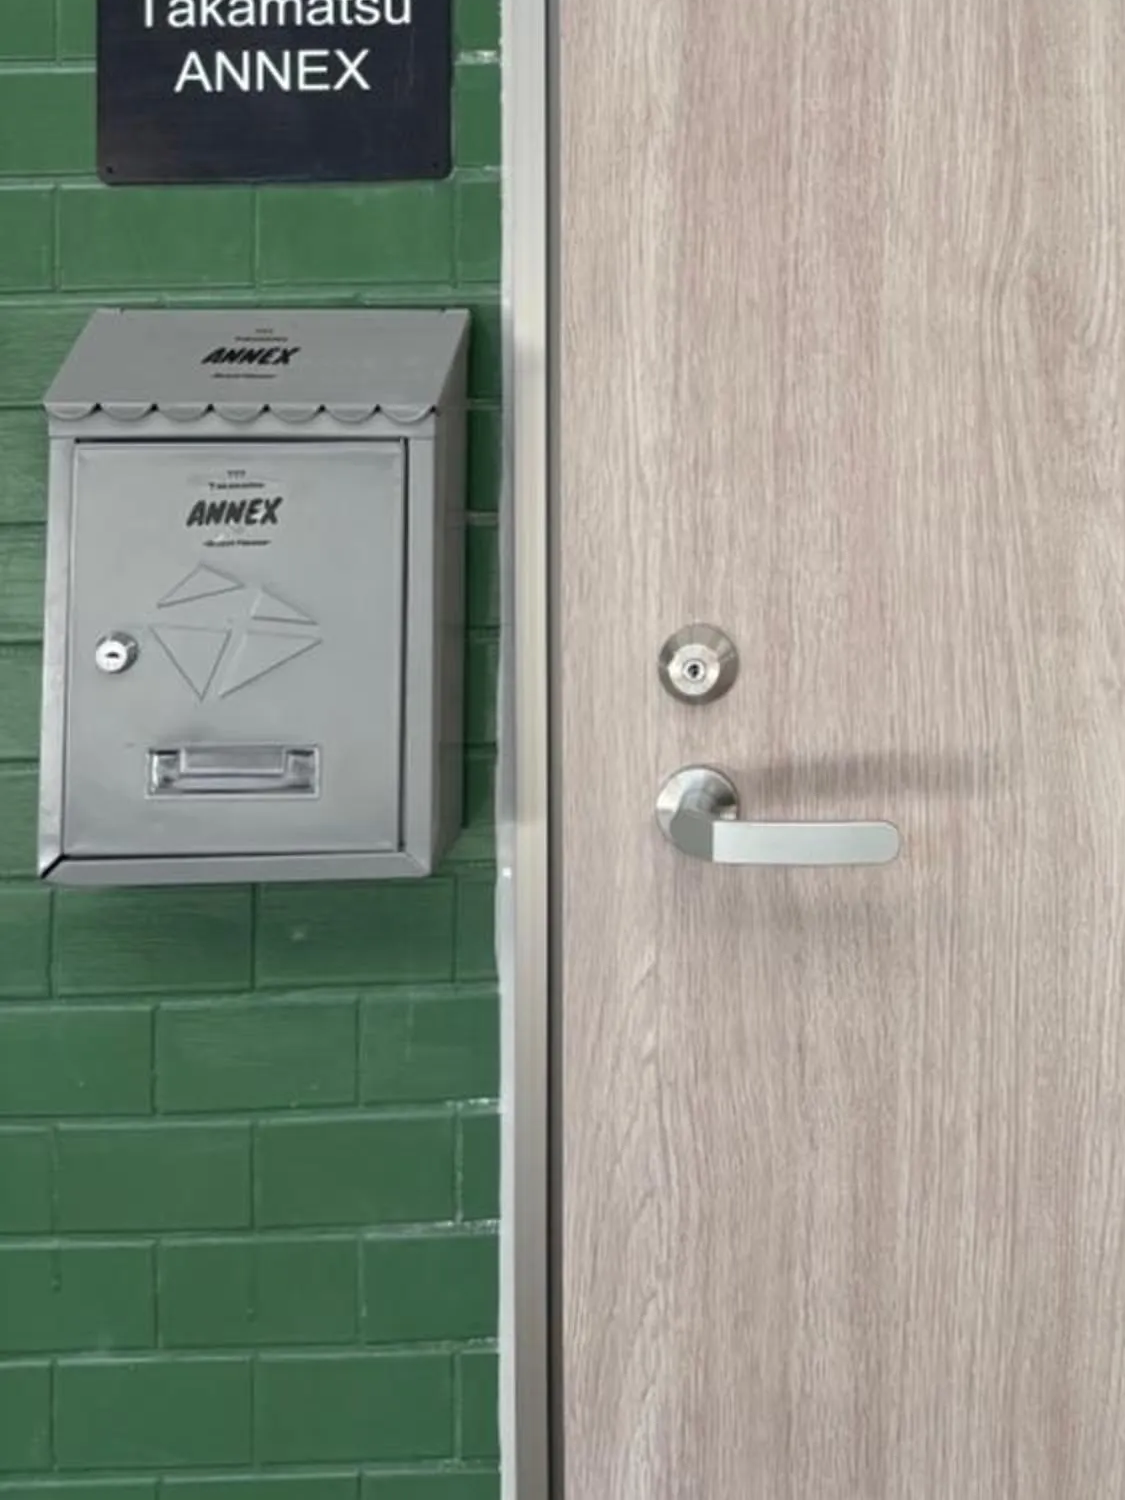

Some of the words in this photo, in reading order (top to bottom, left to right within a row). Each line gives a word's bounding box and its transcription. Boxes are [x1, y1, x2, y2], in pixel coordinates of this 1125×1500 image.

[174, 49, 371, 93] ANNEX
[200, 346, 301, 365] ANNEX
[186, 496, 283, 527] ANNEX
